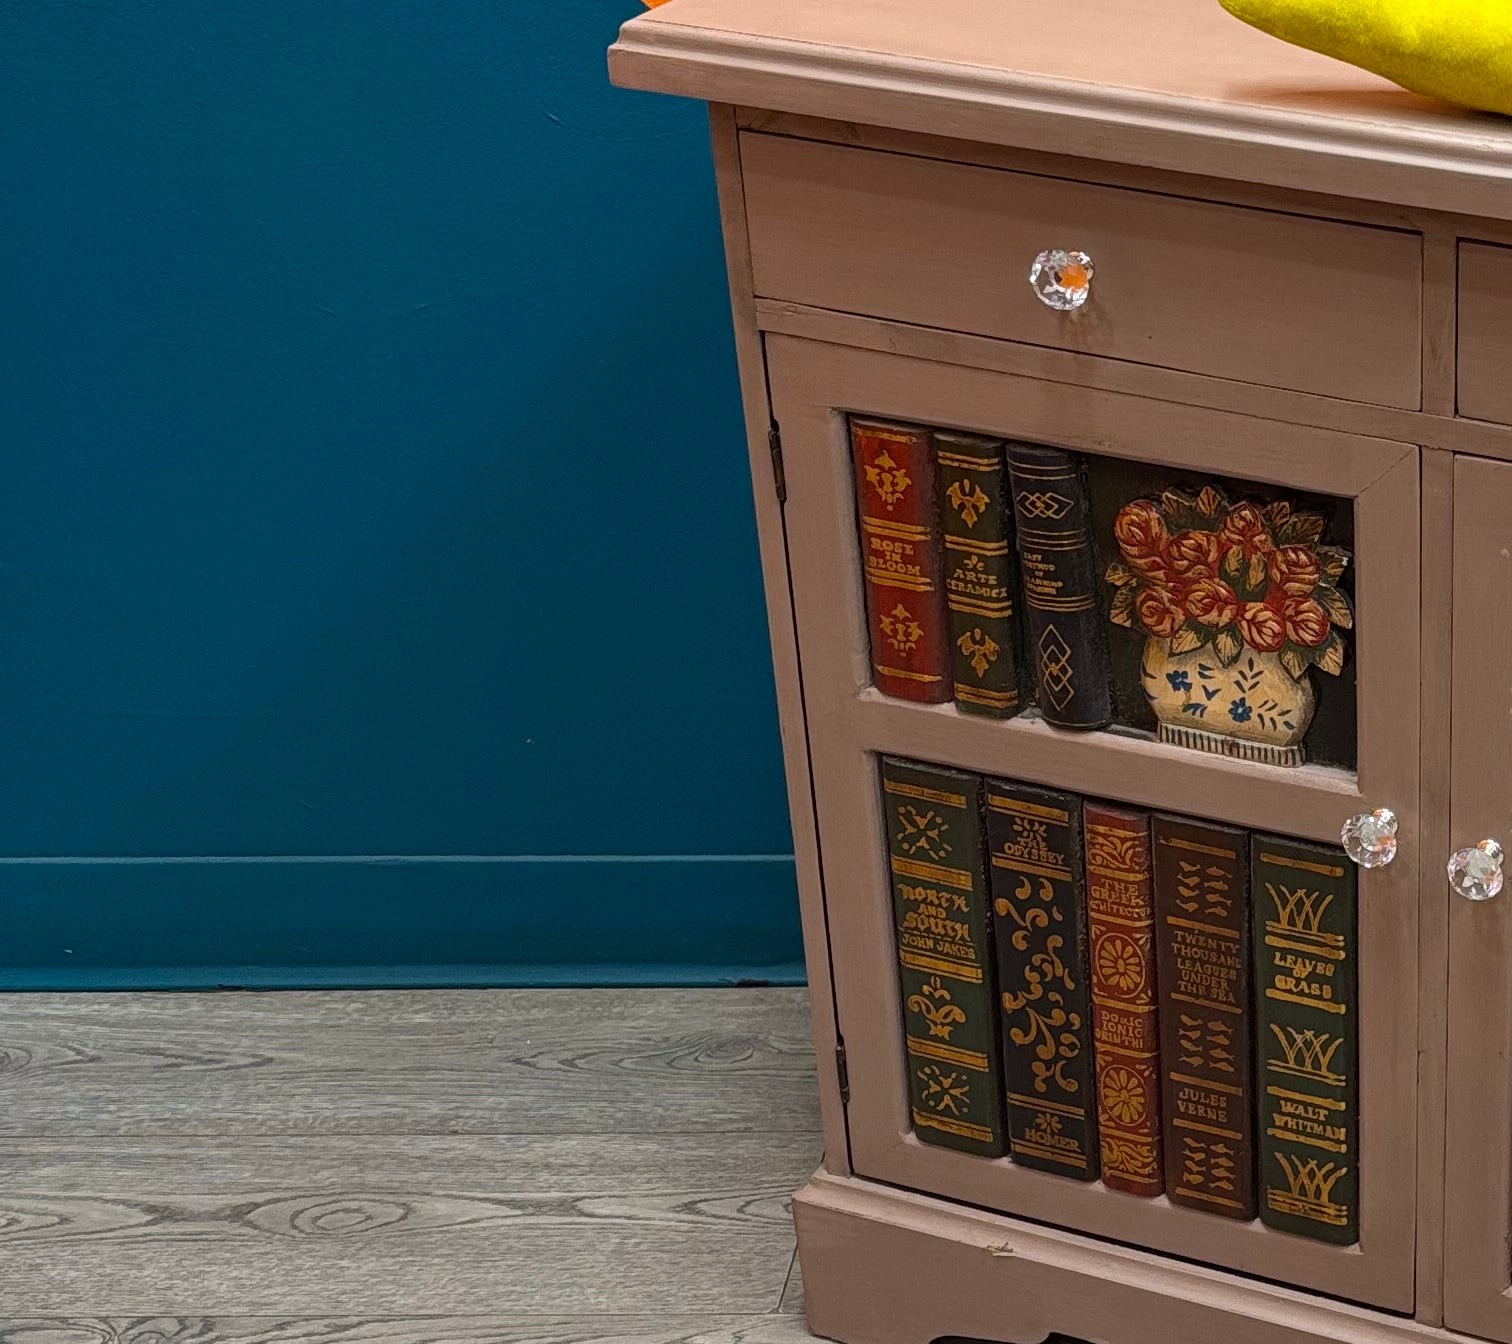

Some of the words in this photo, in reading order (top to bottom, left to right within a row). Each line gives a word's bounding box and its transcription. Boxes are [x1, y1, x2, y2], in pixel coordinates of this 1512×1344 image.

[870, 537, 914, 556] ROSE
[885, 551, 902, 562] IN
[868, 556, 921, 576] BLOOM
[1003, 842, 1065, 865] ODYSSEY
[896, 883, 970, 913] NORTH
[1091, 886, 1145, 906] GREEK
[1101, 878, 1139, 896] THE
[917, 903, 947, 919] AND
[903, 911, 971, 942] SOUTH
[902, 934, 934, 949] JOHN
[936, 940, 976, 960] JAKES
[1174, 930, 1240, 953] TWENTY
[1176, 957, 1237, 981] LEAGUES
[1181, 970, 1230, 991] UNDER
[1177, 980, 1206, 996] THE
[1210, 988, 1236, 1004] SEA
[1101, 1010, 1143, 1027] DORIC
[1102, 1020, 1143, 1038] IONIC
[1179, 1087, 1227, 1108] JULES
[1177, 1100, 1228, 1123] VERNE
[1280, 1099, 1329, 1121] WALT
[1272, 1112, 1347, 1141] WHITMAN
[1024, 1128, 1081, 1152] HOMER
